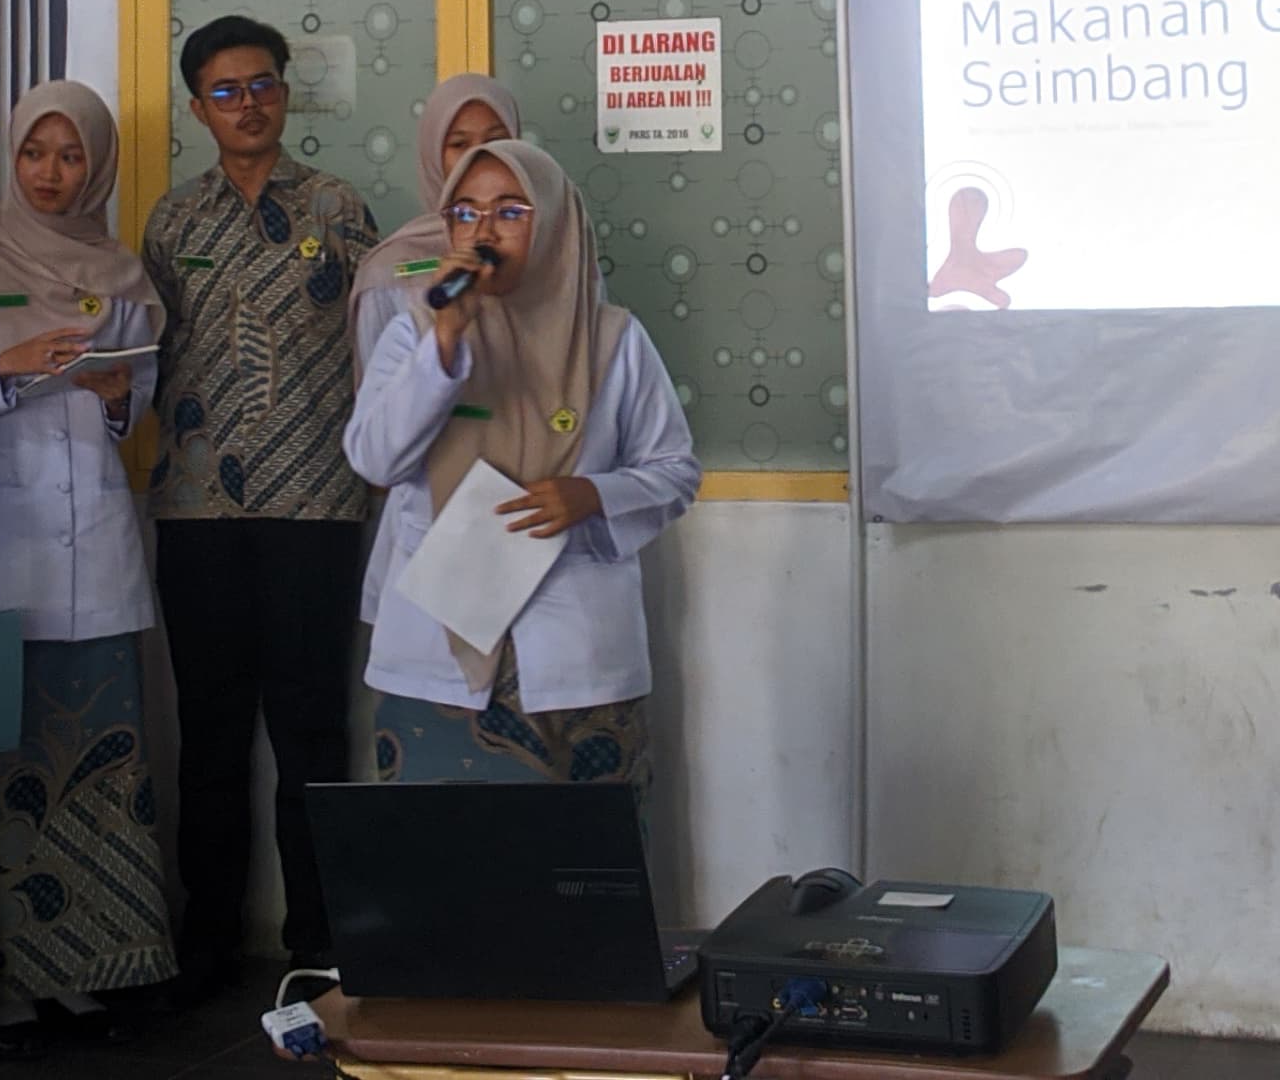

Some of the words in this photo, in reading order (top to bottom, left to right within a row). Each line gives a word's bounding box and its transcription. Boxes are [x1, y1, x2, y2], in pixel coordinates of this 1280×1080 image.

[602, 33, 625, 56] DI
[631, 30, 716, 54] LARANG
[610, 63, 707, 84] BERJUALAN
[963, 53, 1249, 111] Seimbang
[606, 91, 623, 109] DI
[626, 91, 666, 109] AREA
[670, 90, 692, 108] INI
[696, 89, 712, 108] !!!
